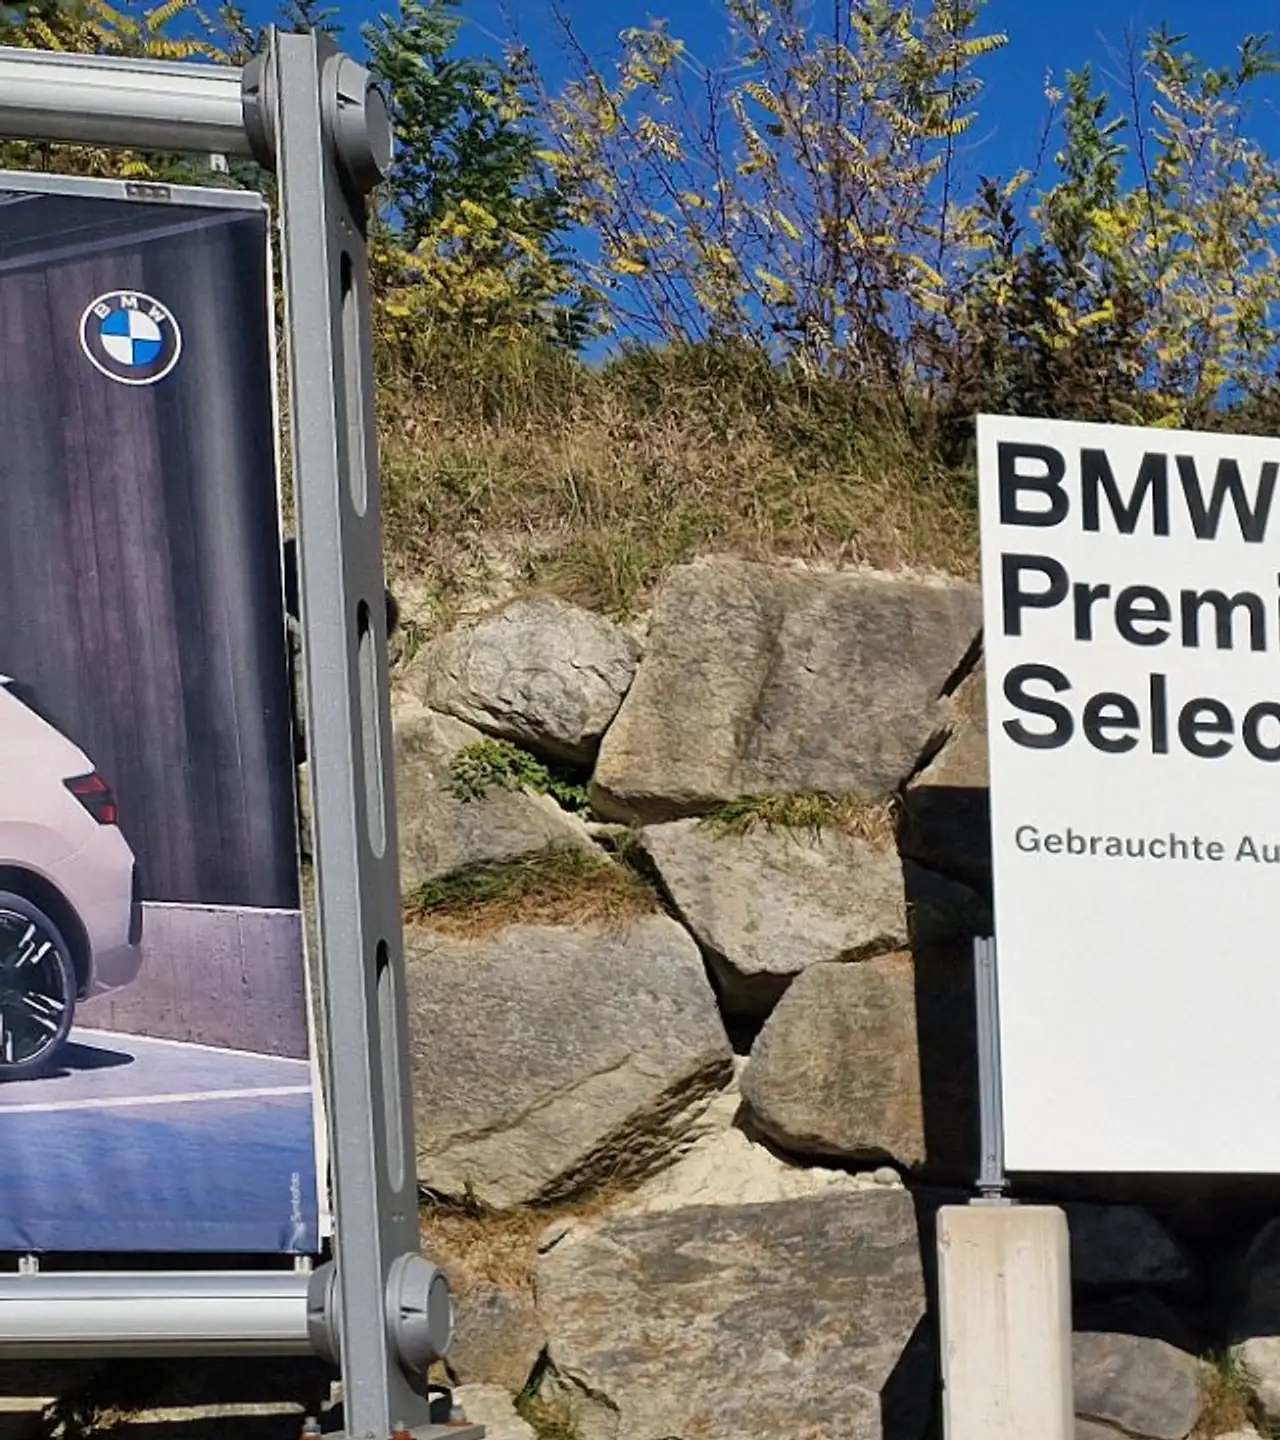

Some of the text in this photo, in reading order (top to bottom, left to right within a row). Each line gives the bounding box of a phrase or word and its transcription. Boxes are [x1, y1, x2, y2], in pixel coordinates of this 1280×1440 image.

[93, 296, 165, 322] BMW
[998, 442, 1280, 543] BMW
[1016, 825, 1224, 862] Gebrauchte
